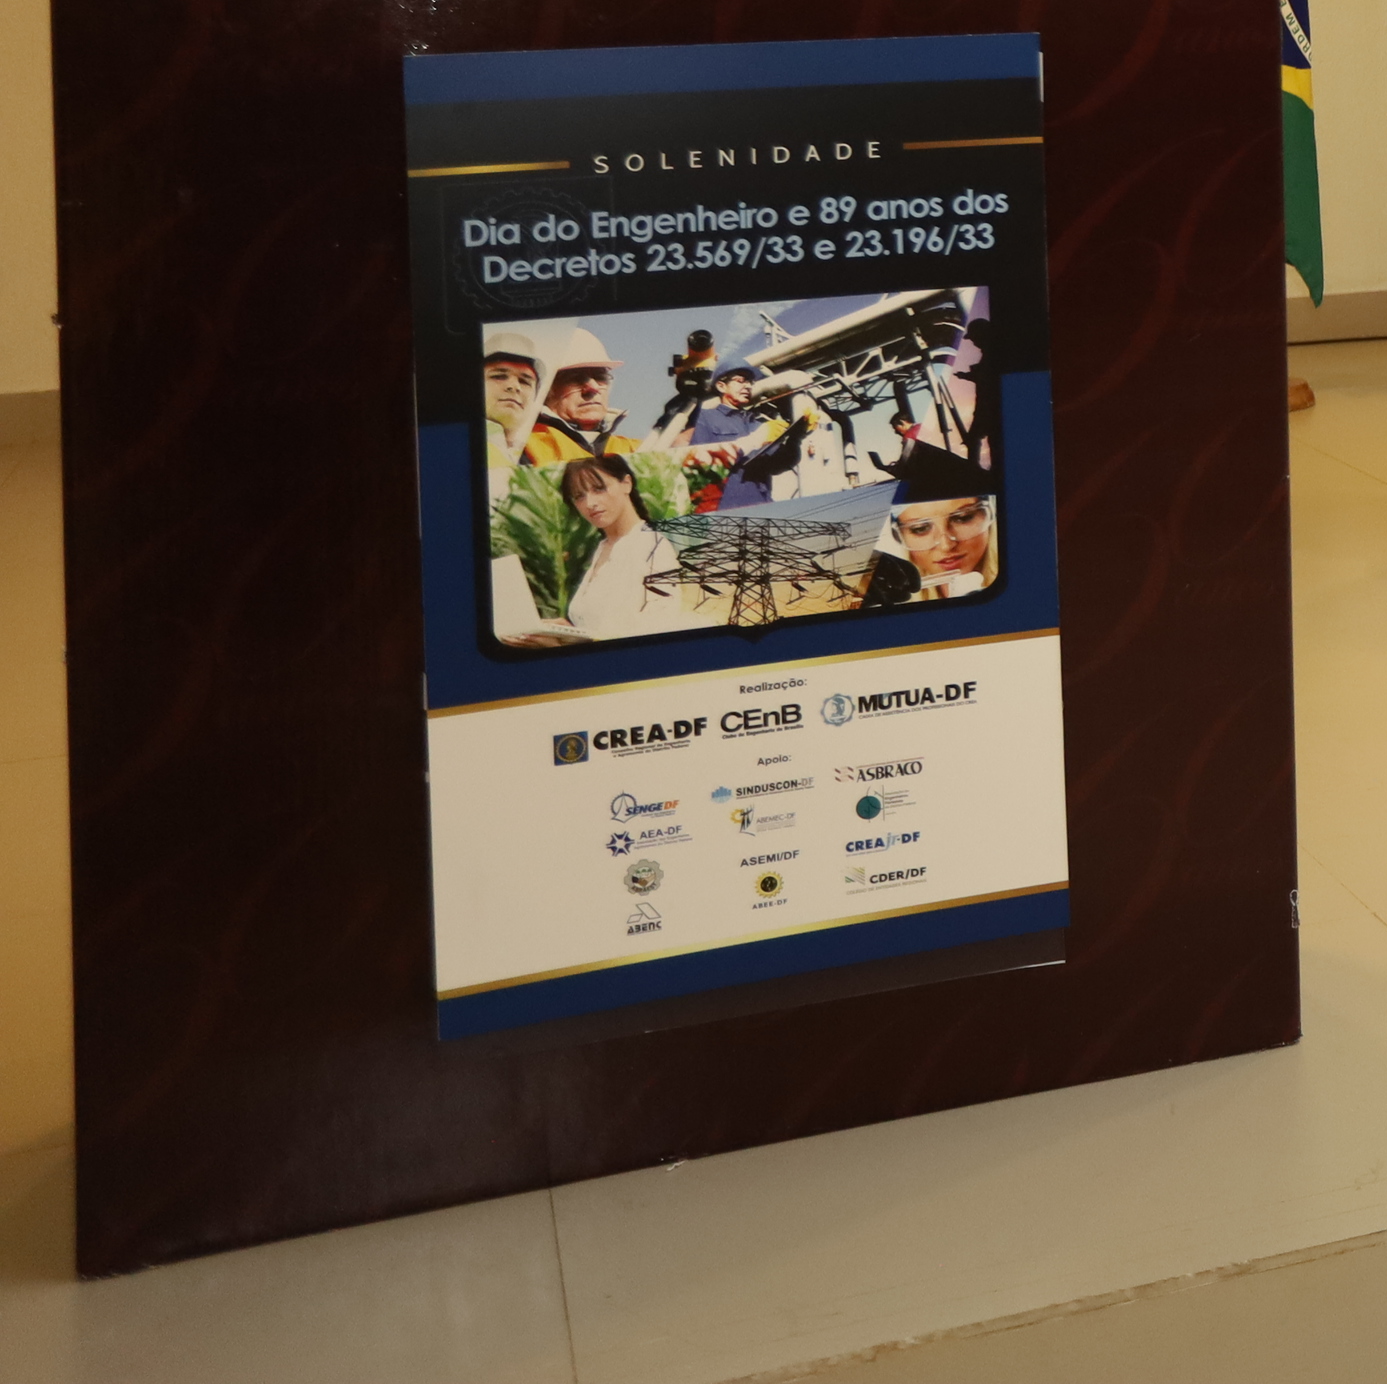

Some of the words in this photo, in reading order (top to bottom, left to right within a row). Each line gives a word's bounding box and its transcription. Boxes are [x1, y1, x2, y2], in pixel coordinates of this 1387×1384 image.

[593, 141, 882, 174] SOLENIDADE
[464, 217, 521, 248] Dia
[533, 213, 580, 243] do
[592, 202, 779, 242] Engenheiro
[788, 204, 810, 227] e
[819, 196, 857, 224] 89
[866, 196, 944, 221] anos
[953, 189, 1009, 216] dos
[484, 248, 637, 284] Decretos
[647, 234, 805, 273] 23.569/33
[815, 238, 836, 262] e
[846, 222, 996, 261] 23.196/33
[739, 678, 807, 695] Realização:
[593, 717, 707, 750] CREA-DF
[720, 703, 802, 733] CEnB
[757, 754, 792, 766] Apoio:
[856, 760, 923, 783] ASBRACO
[736, 776, 815, 797] SINDUSCON-DF
[640, 824, 683, 840] AEA-DF
[740, 849, 800, 868] ASEMI/DF
[869, 866, 927, 885] CDER/DF
[752, 898, 788, 910] ABEE-DF
